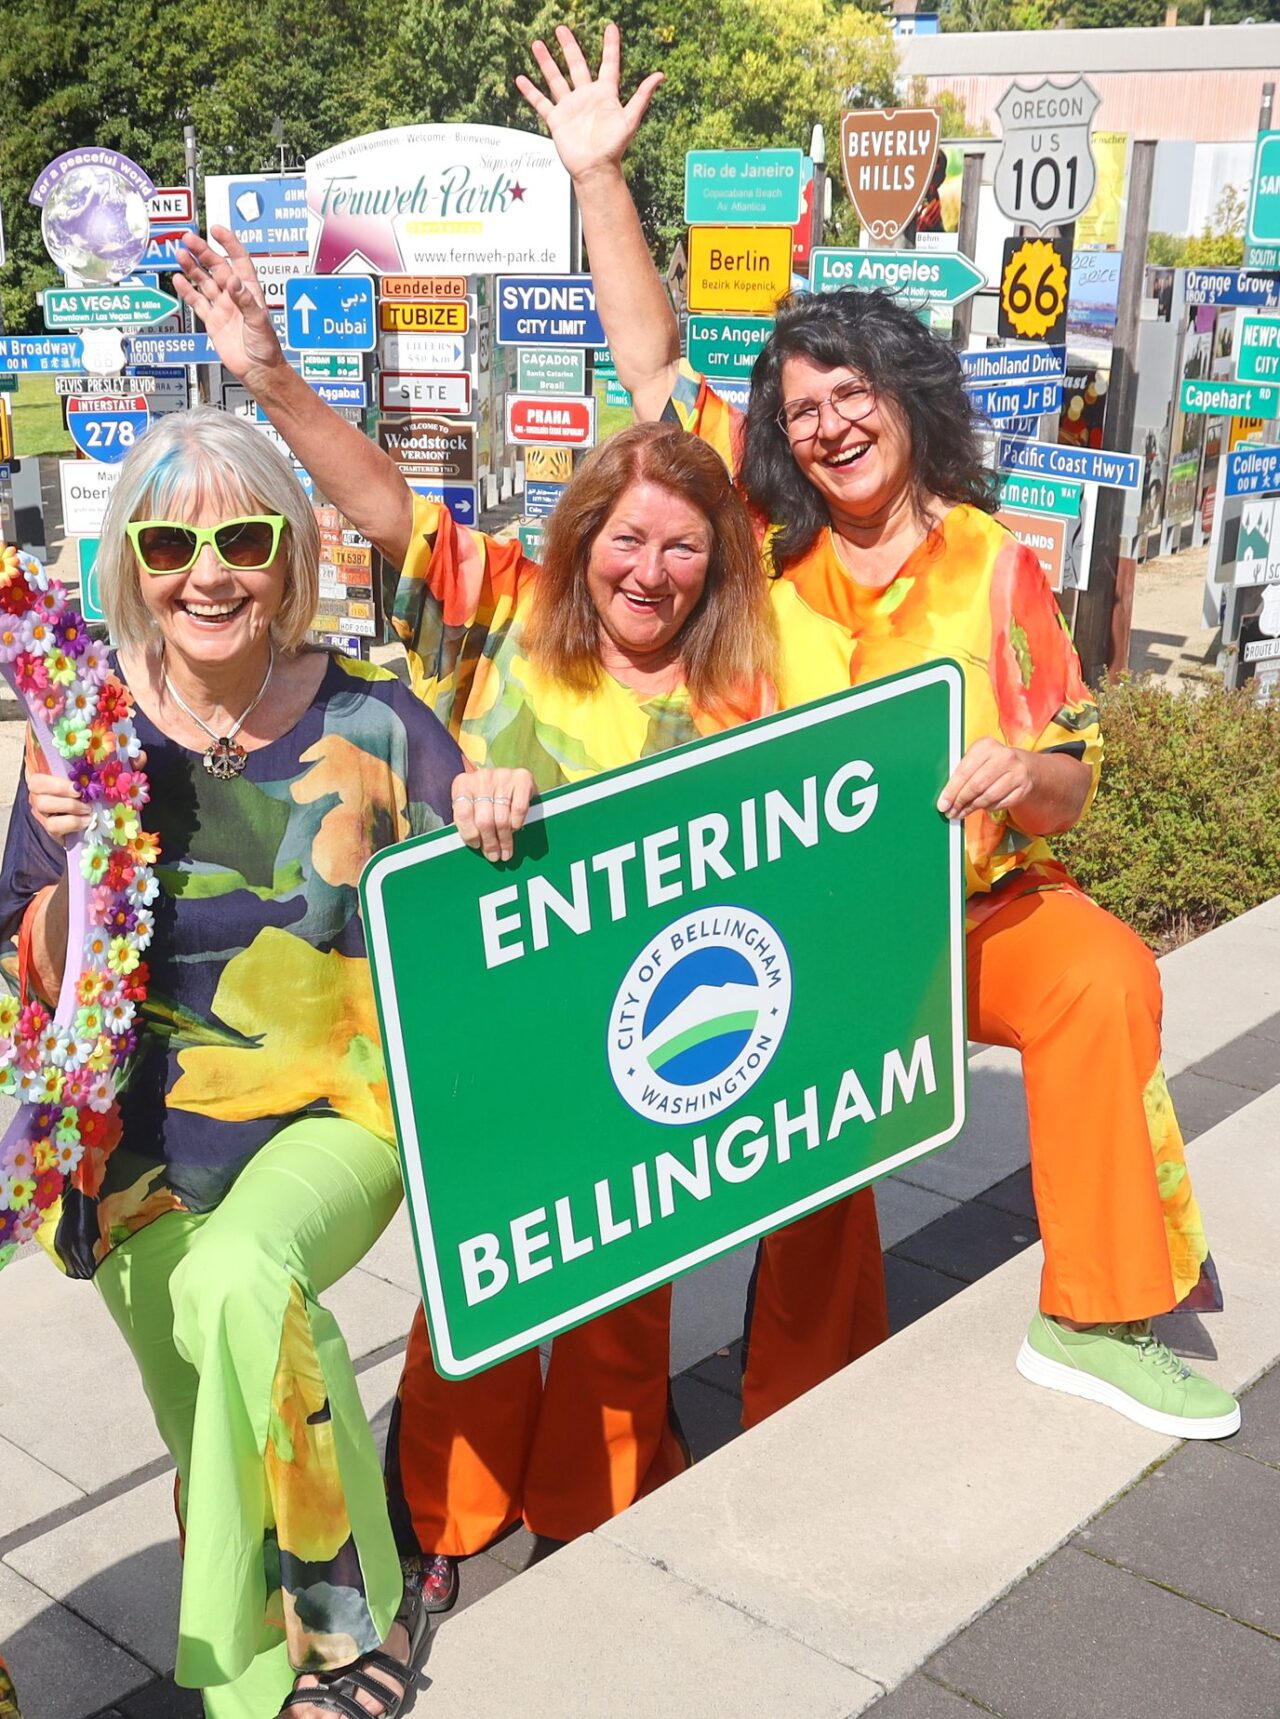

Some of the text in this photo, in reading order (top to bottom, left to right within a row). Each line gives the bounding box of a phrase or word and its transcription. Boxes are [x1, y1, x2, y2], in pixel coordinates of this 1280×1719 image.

[1012, 97, 1084, 120] OREGON
[315, 131, 501, 171] Herzlich Willkommen Welcome Bienvenue
[848, 129, 931, 158] BEVERLY
[33, 152, 153, 202] For a peaceful world
[693, 162, 794, 178] Rio de Janeiro
[859, 164, 916, 191] HILLS
[1012, 155, 1078, 211] 101
[703, 187, 783, 199] Copacabana Beach
[916, 233, 940, 243] Böhm
[414, 248, 556, 265] www.fernweh-park.de
[710, 249, 771, 273] Berlin
[1248, 248, 1276, 267] SOUTH
[822, 257, 941, 286] Los Angeles
[385, 280, 461, 296] Lendelede
[701, 278, 776, 292] Bezirk Köpenick
[1008, 263, 1059, 316] 66
[1186, 270, 1274, 297] Orange Grove
[51, 295, 161, 312] LAS VEGAS Miles
[340, 290, 367, 311] دبي
[502, 286, 597, 311] SYDNEY
[1186, 290, 1206, 303] 1800
[52, 310, 152, 323] Downtown Las Vegas Blvd.
[389, 307, 458, 326] TUBIZE
[323, 317, 367, 335] Dubai
[516, 319, 587, 336] CITY LIMIT
[692, 324, 718, 341] Los
[11, 338, 77, 361] Broadway
[129, 337, 196, 352] Tennessee
[129, 352, 166, 363] 11000 W
[522, 353, 579, 368] CAÇADOR
[707, 352, 729, 366] CITY
[1033, 353, 1063, 373] Drive
[1255, 354, 1280, 375] CITY
[526, 369, 574, 378] Santa Catarina
[60, 378, 152, 393] ELVIS PRESLEY BLVD
[539, 380, 565, 390] Brasil
[77, 399, 137, 411] INTERSTATE
[986, 386, 1058, 416] King Jr Bl
[1185, 385, 1271, 412] Capehart RD
[527, 409, 571, 425] PRAHA
[85, 420, 136, 447] 278
[402, 422, 438, 433] WELCOME
[385, 433, 468, 450] Woodstock
[400, 449, 451, 461] VERMONT
[1002, 443, 1136, 484] Pacific Coast Hwy 1
[399, 464, 440, 473] CHARTERED
[1233, 454, 1277, 478] College
[1060, 486, 1077, 499] WAY
[1250, 643, 1272, 657] ROUTE
[479, 759, 880, 970] ENTERING
[617, 917, 783, 1050] CITY OF BELLINGHAM
[641, 1034, 773, 1114] WASHINGTON
[458, 1035, 938, 1308] BELLINGHAM
